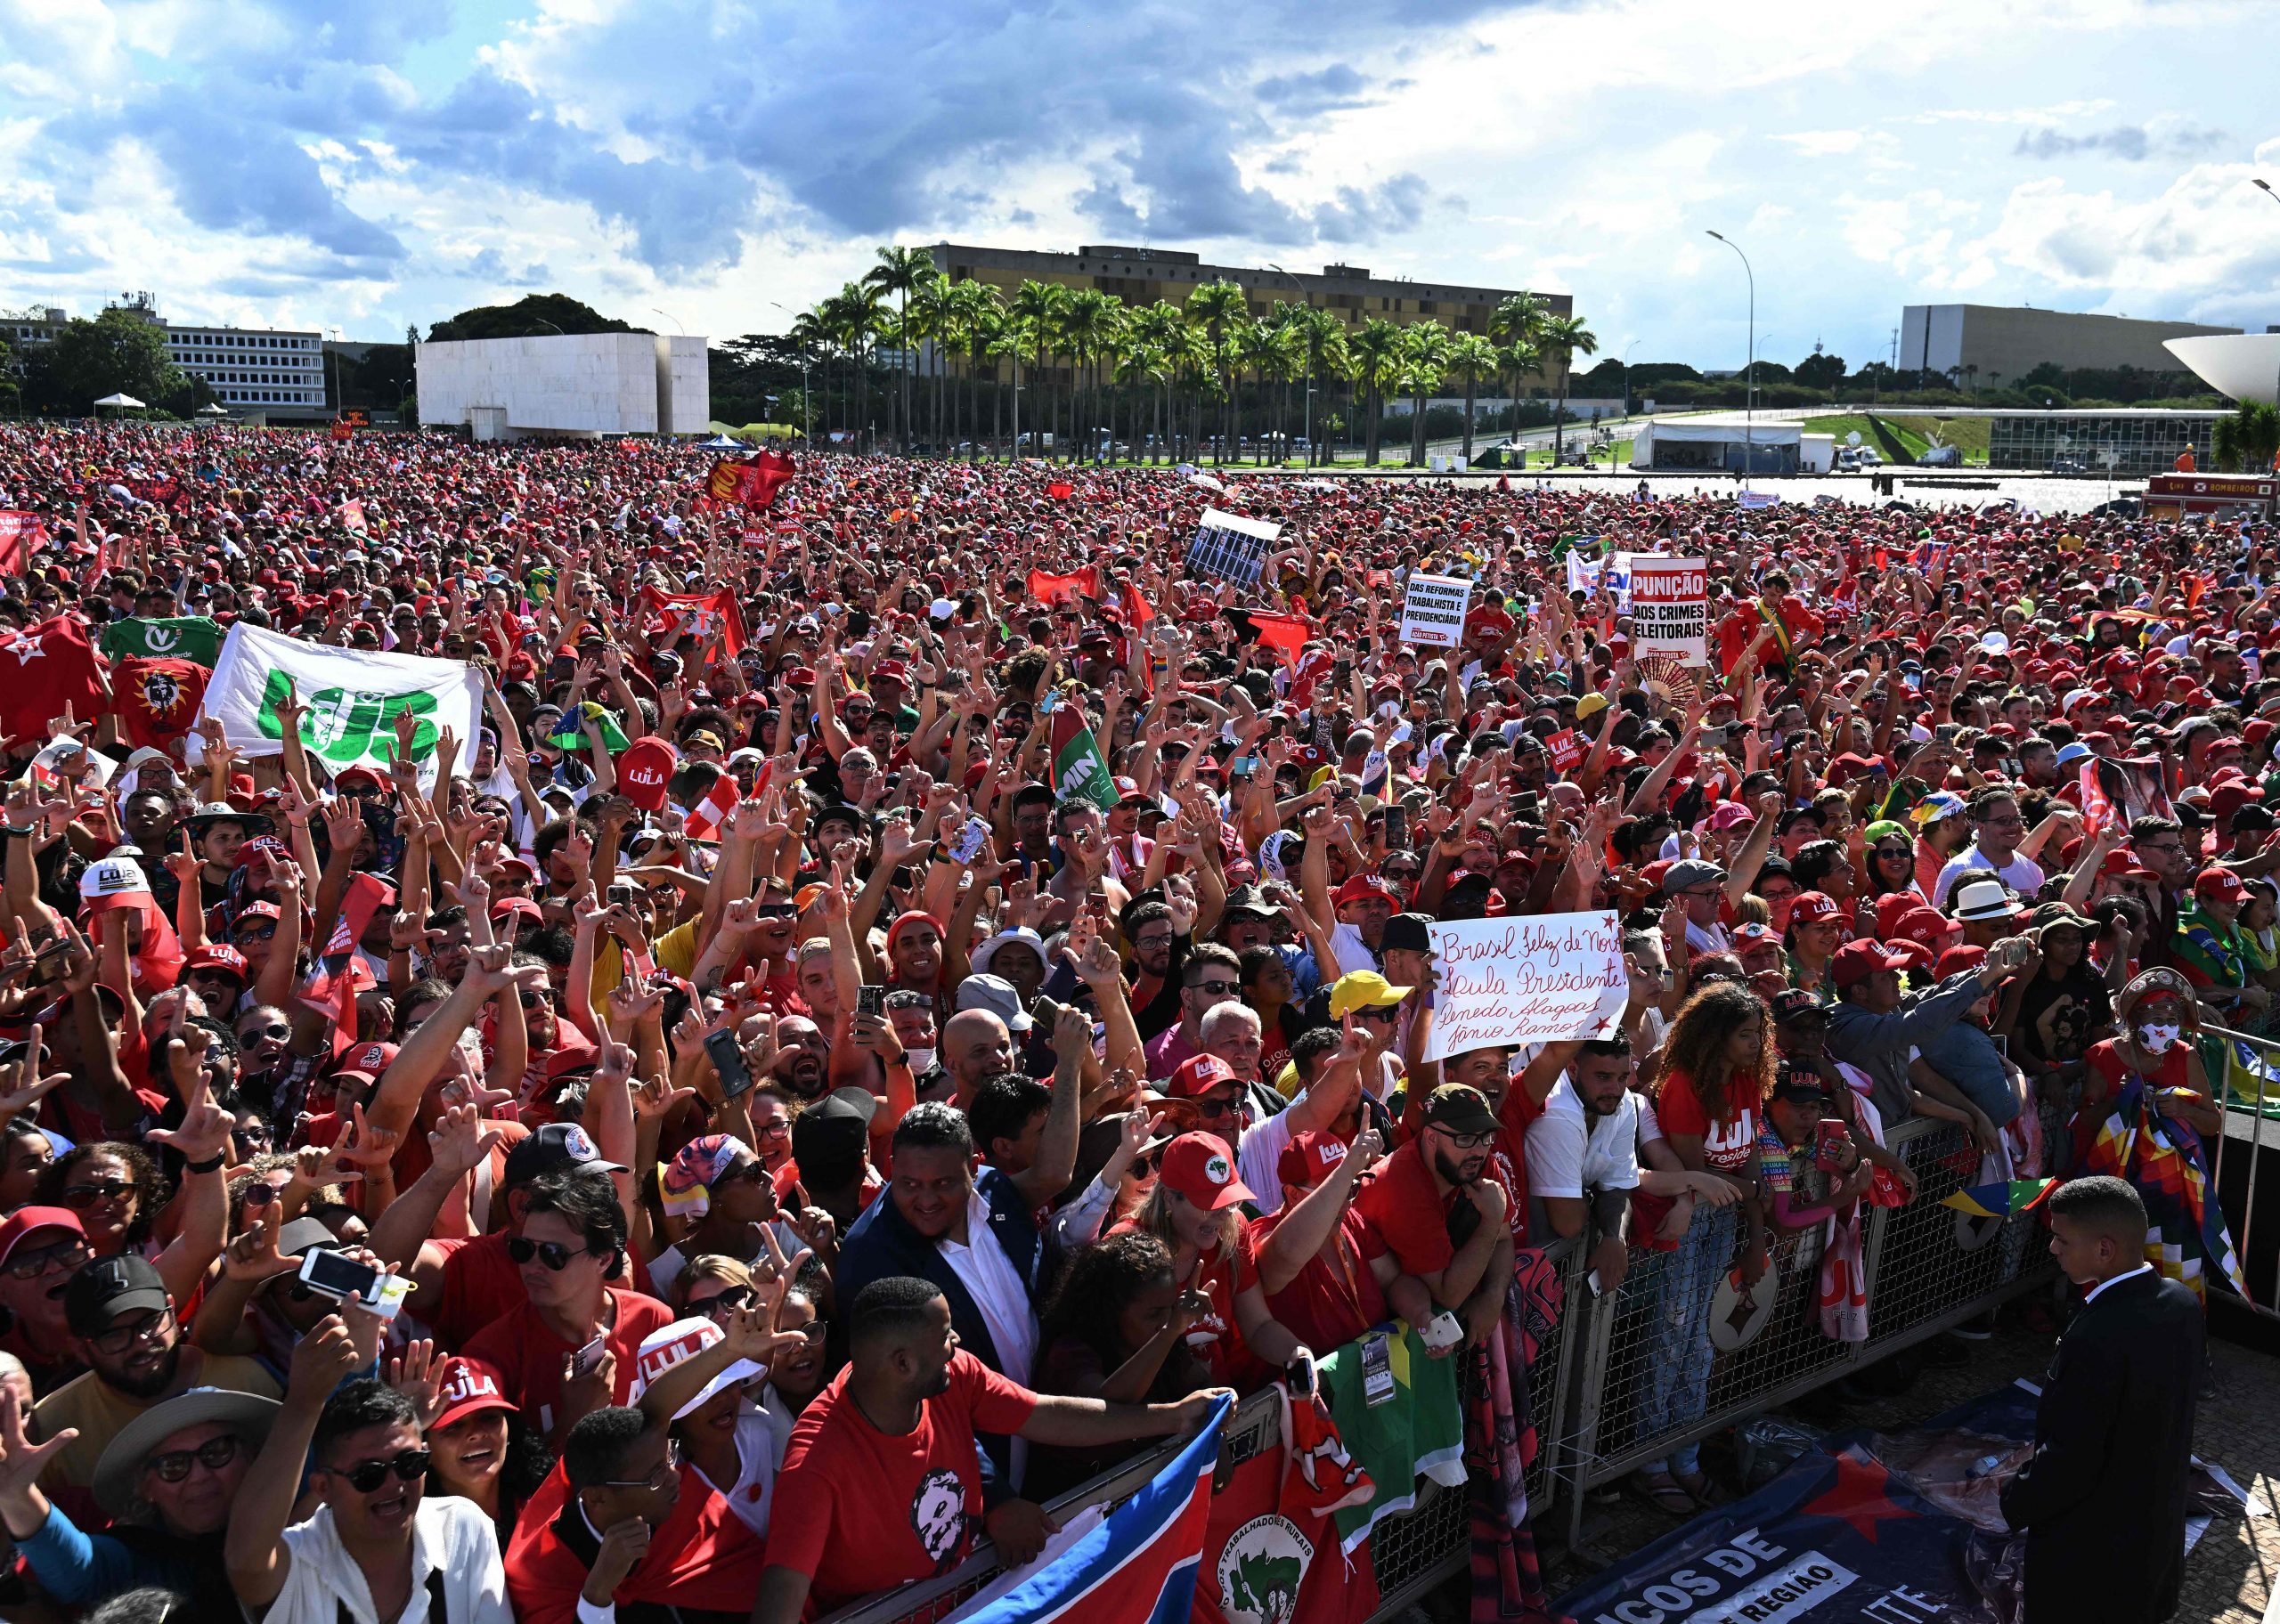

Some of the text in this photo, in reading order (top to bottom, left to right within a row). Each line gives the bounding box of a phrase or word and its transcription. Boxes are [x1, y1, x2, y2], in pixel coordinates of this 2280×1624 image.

[2210, 483, 2256, 493] BOMBEIROS
[744, 532, 764, 540] LULA
[1410, 582, 1464, 597] DAS REFORMAS
[1633, 572, 1704, 601] PUNIÇÃO
[1408, 596, 1462, 612] TRABALHISTA E
[1633, 604, 1705, 621] AOS CRIMES
[1405, 611, 1461, 626] PREVIDENCIÁRIA
[1634, 621, 1705, 640] ELEITORAIS
[1551, 737, 1574, 754] LUL
[629, 768, 664, 785] LULA
[1728, 806, 1748, 817] LULA
[253, 838, 285, 852] LULA
[99, 865, 136, 882] Lula
[240, 905, 276, 916] LULA
[1442, 925, 1517, 967] Brasil
[1563, 925, 1584, 953] de
[209, 946, 242, 968] LULA
[1517, 958, 1628, 996] Presidente!
[360, 1060, 380, 1068] LULA
[1194, 1060, 1226, 1080] LULA
[1705, 1108, 1755, 1152] Lul
[1704, 1146, 1751, 1165] Preside
[642, 1330, 721, 1381] LULA
[445, 1375, 499, 1402] ULA
[1221, 1516, 1285, 1565] TRABALHADORES
[1285, 1522, 1313, 1557] RURAIS
[1704, 1527, 1788, 1579] DE
[1738, 1564, 1834, 1623] REGIÃO
